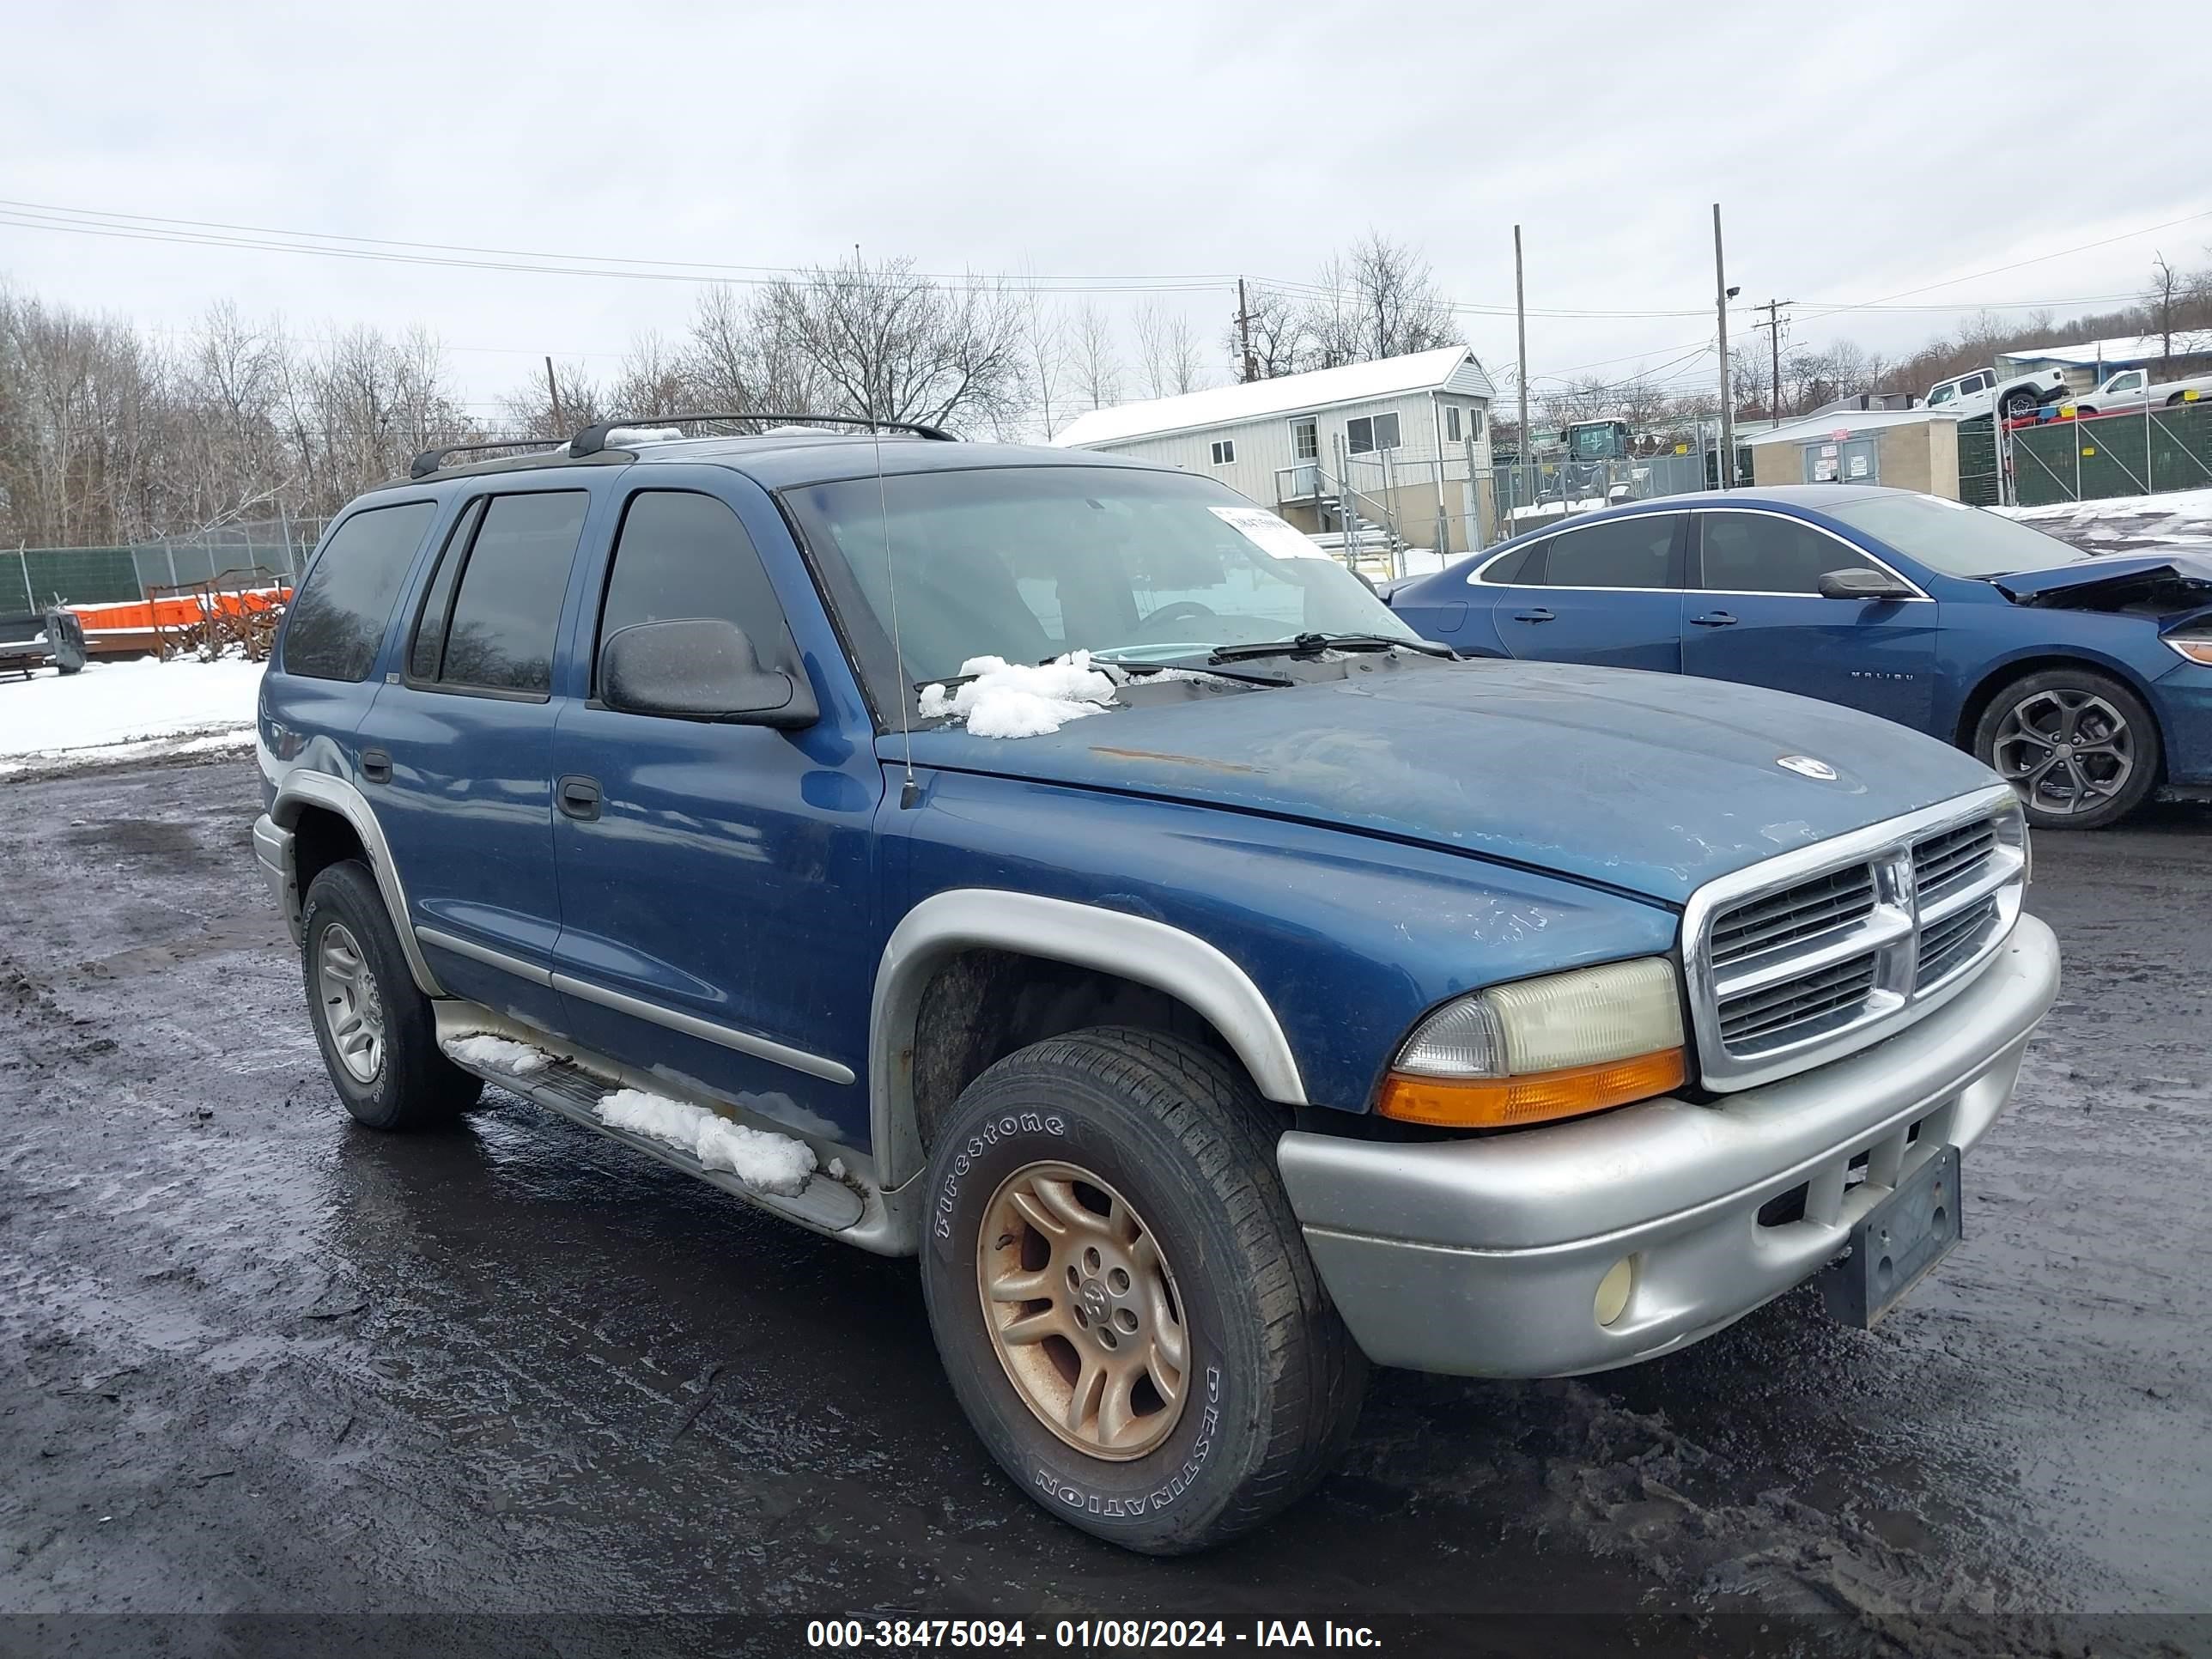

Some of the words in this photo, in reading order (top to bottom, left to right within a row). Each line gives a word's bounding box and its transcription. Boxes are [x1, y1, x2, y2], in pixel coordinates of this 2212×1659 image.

[1850, 672, 1914, 681] MALIBU
[934, 1113, 1065, 1238] Firestone
[1035, 1366, 1220, 1517] DESTINATION
